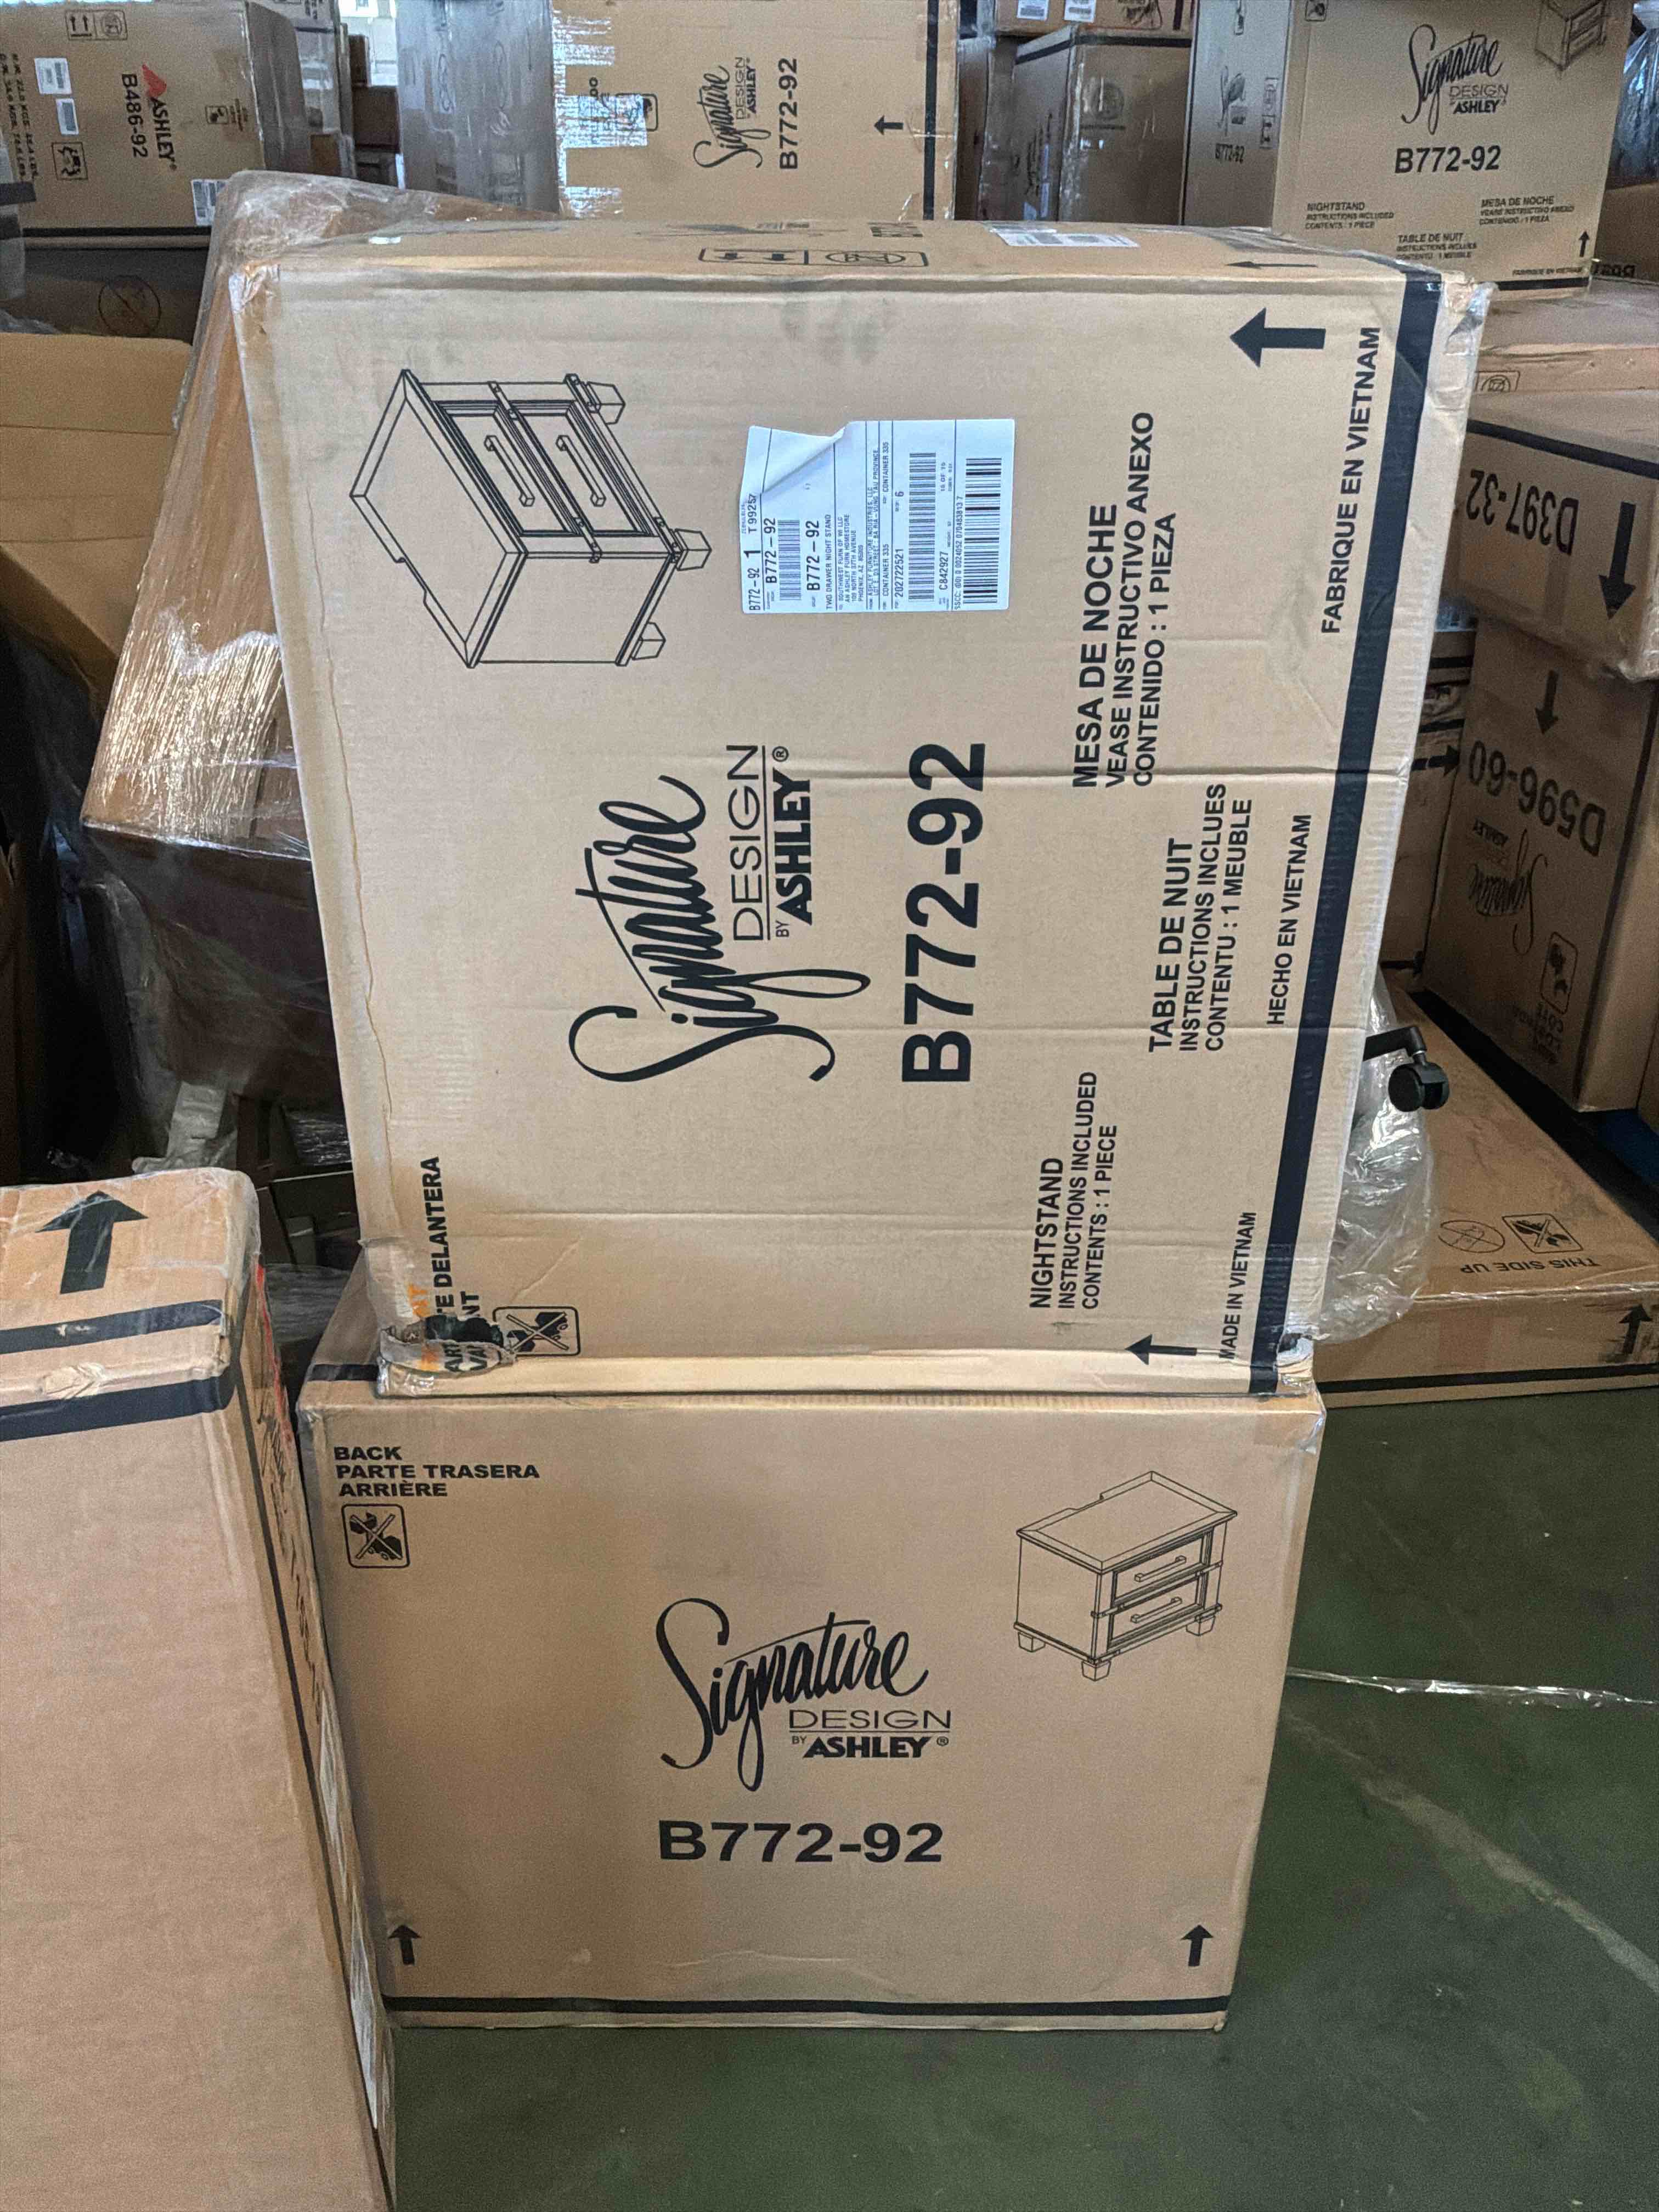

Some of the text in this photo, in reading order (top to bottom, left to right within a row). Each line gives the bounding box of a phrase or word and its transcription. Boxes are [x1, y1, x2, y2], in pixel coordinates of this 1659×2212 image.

[121, 74, 148, 158] B486-92
[693, 65, 771, 168] Signature
[735, 57, 746, 120] DESIGN
[746, 66, 756, 114] ASHLEY
[778, 58, 798, 169] B772-92
[1401, 24, 1503, 135] Signature
[1448, 83, 1509, 98] DESIGN
[1453, 99, 1500, 114] ASHLEY
[1395, 145, 1501, 173] B772-92
[1307, 201, 1365, 211] NIGHTSTAND
[1398, 233, 1463, 243] TABLE DE NUIT
[1482, 196, 1554, 207] MESA DE NOCHE
[1321, 328, 1381, 633] FABRIQUE EN VIETNAM
[1465, 470, 1579, 556] D397-32
[764, 518, 777, 583] B772-92
[805, 520, 820, 591] B772-92
[895, 549, 904, 597] 202722521
[939, 551, 948, 590] C842927
[1150, 513, 1176, 592] PIEZA
[747, 568, 760, 611] B772-92
[1105, 413, 1154, 788] VEASE INSTRUCTIVO ANEXO
[1148, 604, 1169, 614] 1
[1072, 504, 1117, 787] MESA DE NOCHE
[1133, 640, 1165, 787] CONTENIDO
[1468, 740, 1606, 857] D596-60
[726, 744, 764, 941] DESIGN
[1223, 799, 1252, 896] MEUBLE
[568, 775, 870, 1082] Signature
[776, 920, 789, 938] BY
[901, 743, 985, 1082] B772-92
[1149, 838, 1193, 1052] TABLE DE NUIT
[1179, 783, 1226, 1051] INSTRUCTIONS INCLUES
[1221, 906, 1240, 914] 1
[1266, 815, 1312, 1024] HECHO EN VIETNAM
[1205, 936, 1236, 1051] CONTENTU
[1058, 1071, 1097, 1308] INSTRUCTIONS INCLUDED
[1094, 1126, 1117, 1181] PIECE
[420, 1156, 453, 1287] DELANTERA
[1093, 1188, 1110, 1197] 1
[1029, 1158, 1063, 1308] NIGHTSTAND
[1082, 1213, 1107, 1310] CONTENTS
[1460, 1257, 1601, 1273] THIS SIDE UP
[1218, 1212, 1256, 1359] MADE IN VIETNAM
[334, 1446, 402, 1460] BACK
[336, 1465, 540, 1479] PARTE TRASERA
[339, 1480, 448, 1497] ARRIÈRE
[656, 1598, 929, 1792] Signature
[788, 1709, 951, 1729] DESIGN
[791, 1735, 806, 1745] BY
[659, 1820, 943, 1863] B772-92
